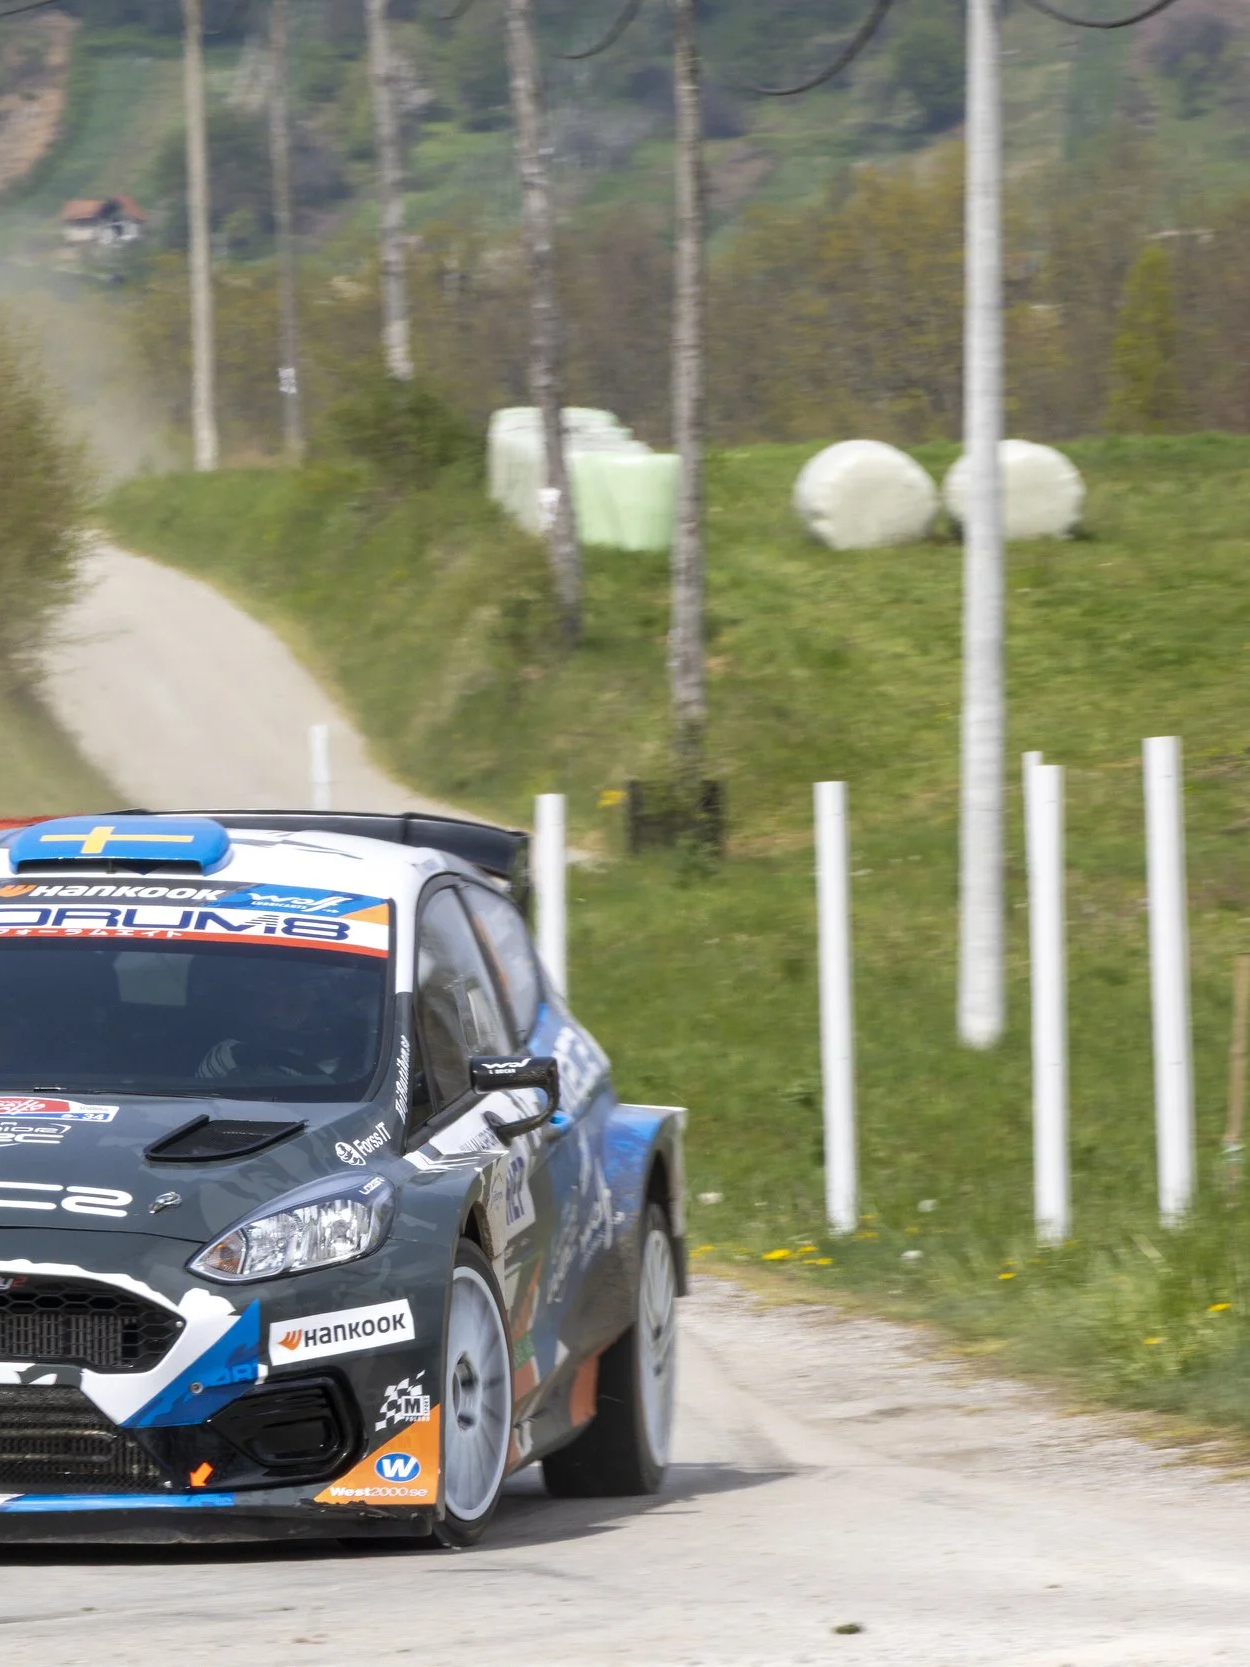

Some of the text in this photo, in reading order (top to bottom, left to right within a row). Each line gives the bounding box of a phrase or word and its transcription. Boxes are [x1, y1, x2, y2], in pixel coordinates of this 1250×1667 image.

[251, 901, 307, 910] LUBRICANTS
[82, 1113, 105, 1121] 34
[404, 1398, 421, 1414] M
[381, 1455, 418, 1477] W
